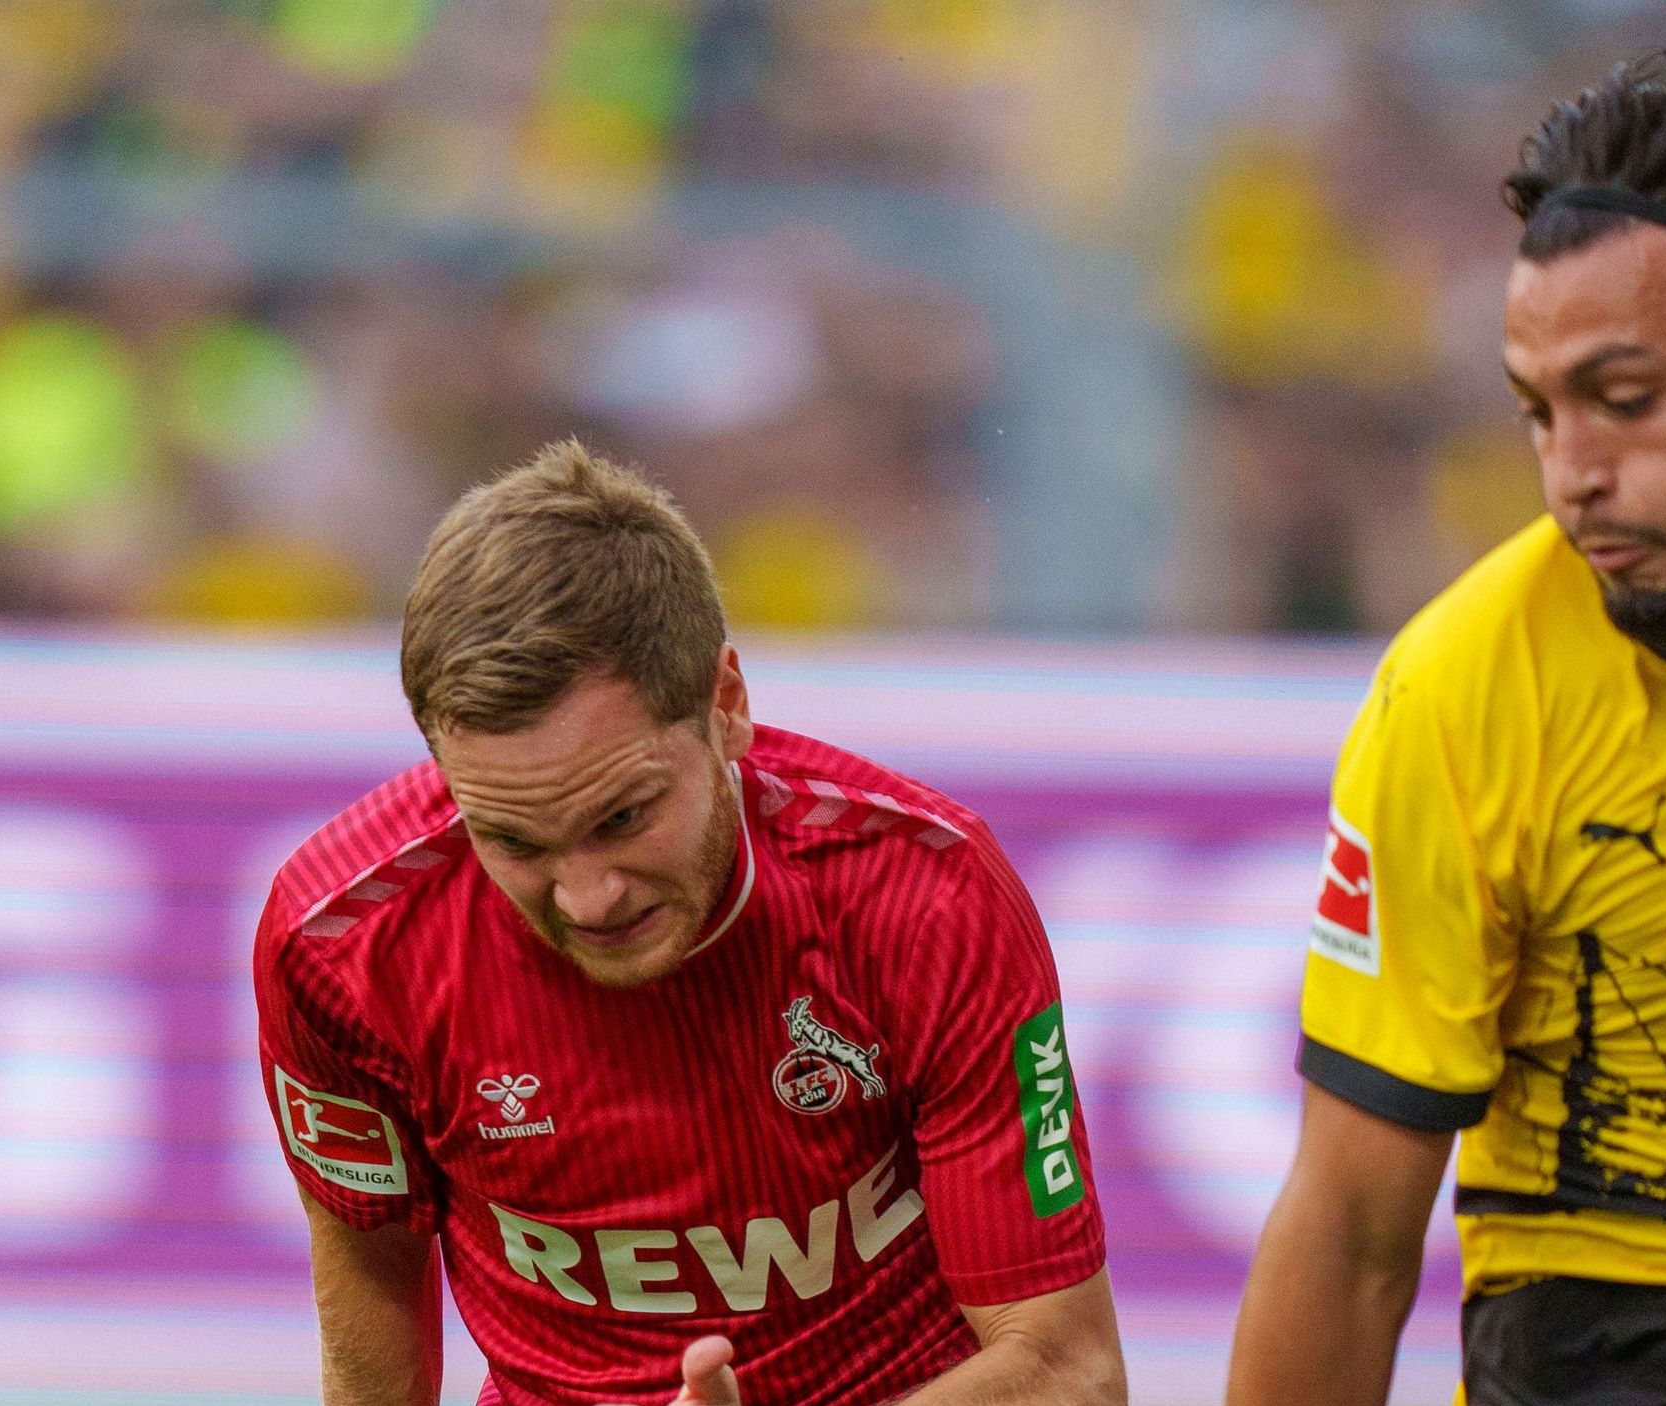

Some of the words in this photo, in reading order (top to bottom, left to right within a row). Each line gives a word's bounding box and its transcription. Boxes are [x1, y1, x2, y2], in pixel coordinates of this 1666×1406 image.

[478, 1115, 555, 1139] hummel
[1030, 1025, 1075, 1195] DEVK
[296, 1144, 396, 1185] BUNDESLIGA
[488, 1138, 925, 1314] REWE
